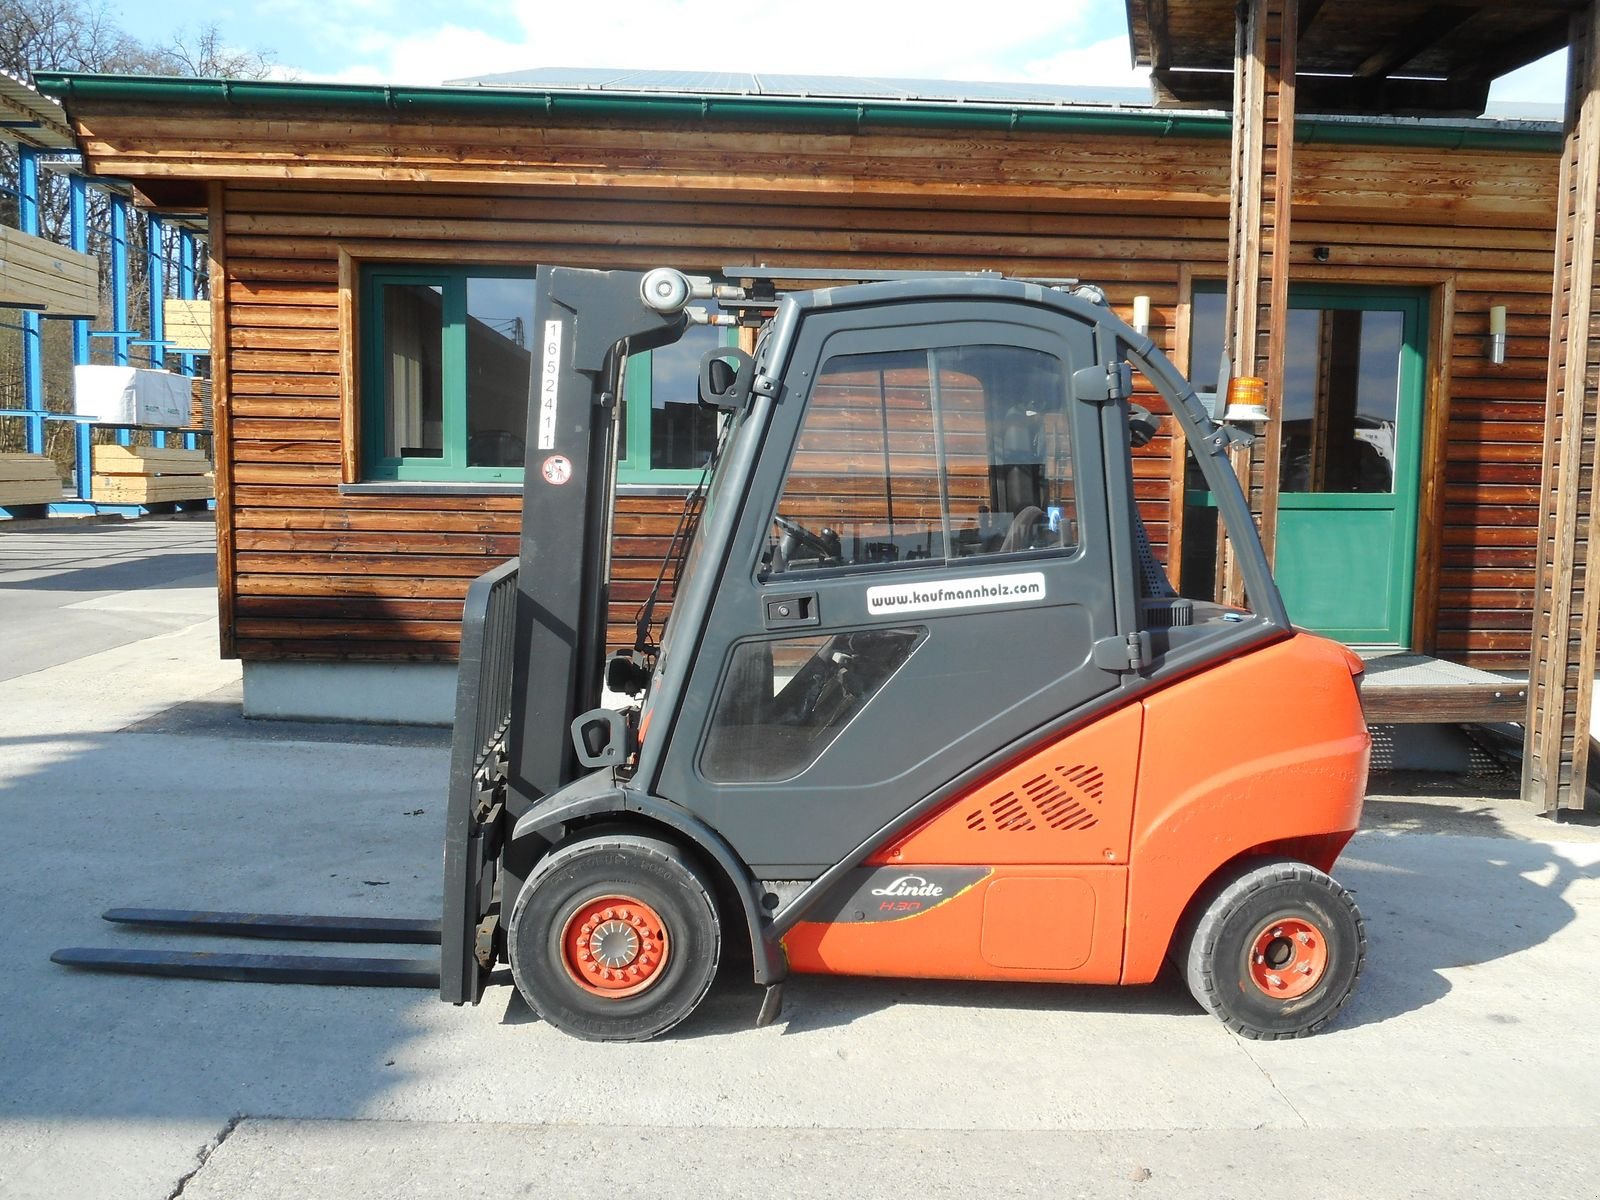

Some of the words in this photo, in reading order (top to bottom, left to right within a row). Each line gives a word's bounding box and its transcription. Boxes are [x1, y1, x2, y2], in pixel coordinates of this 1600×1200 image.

[543, 324, 558, 447] 1652411
[872, 583, 1040, 608] www.kaufmannholz.com
[871, 876, 943, 897] Linde
